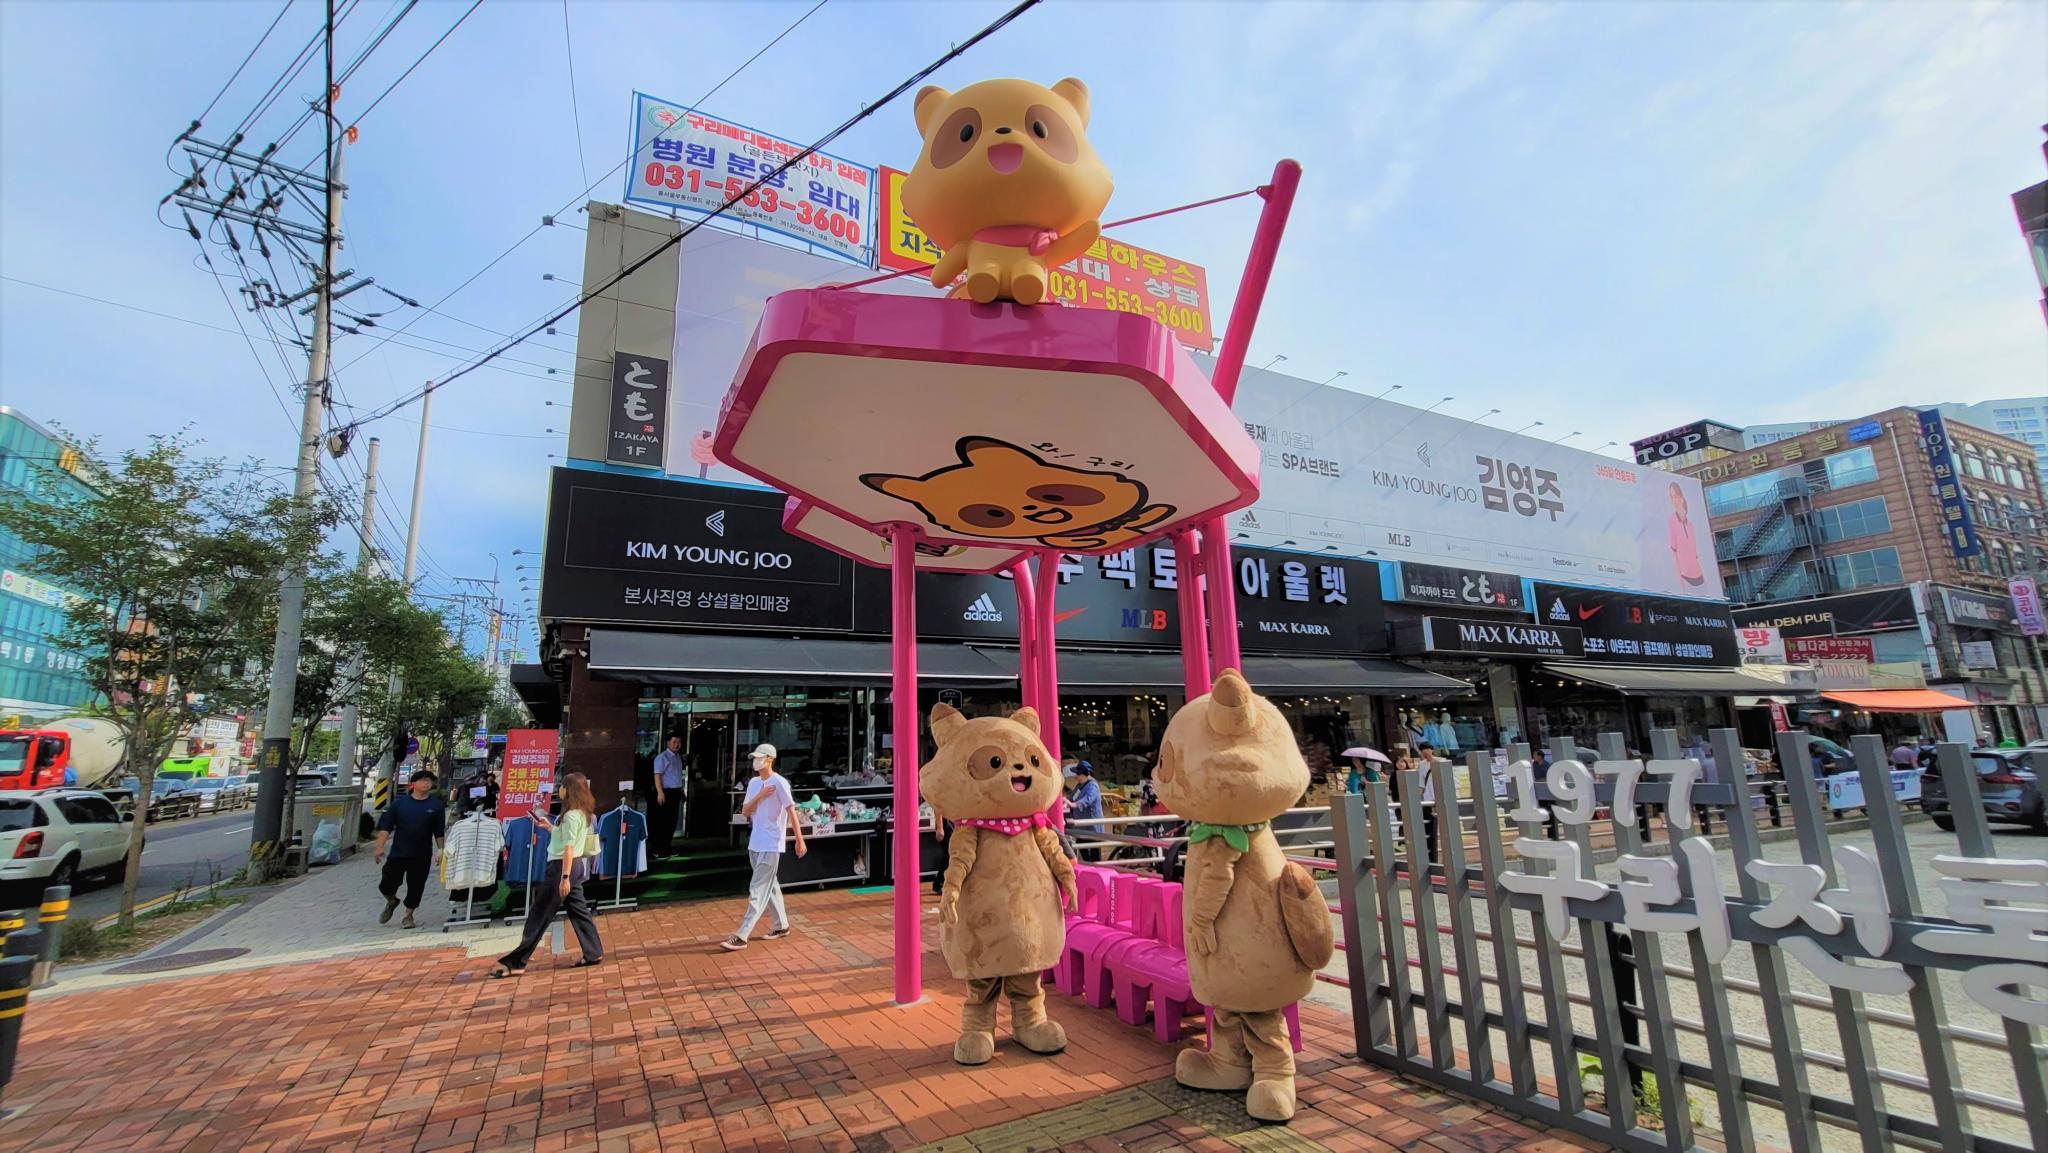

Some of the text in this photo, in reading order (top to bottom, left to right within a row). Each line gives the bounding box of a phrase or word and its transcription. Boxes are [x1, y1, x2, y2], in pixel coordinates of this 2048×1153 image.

[653, 137, 716, 169] 병원
[808, 180, 860, 220] 임대
[645, 162, 860, 245] 031-553-3600
[1050, 271, 1204, 334] 031-553-3600
[1144, 278, 1200, 307] 상담
[624, 361, 658, 421] とも
[614, 430, 659, 443] IZAKAYA
[1642, 426, 1693, 446] MOTEL
[1925, 422, 1943, 457] TOP
[626, 445, 647, 456] 1F
[1636, 433, 1702, 465] TOP
[1282, 453, 1340, 477] SPA브랜드
[1372, 455, 1564, 522] KIM YOUNG JOO 김영주
[1388, 532, 1412, 548] MLB
[626, 541, 792, 570] KIM YOUNG JOO
[624, 586, 790, 613] 본사직영 상설할인매장
[1442, 588, 1457, 599] 도모
[1462, 574, 1496, 604] とも
[1510, 598, 1518, 607] 1F
[963, 609, 1003, 623] adidas
[1121, 607, 1168, 631] MLB
[1550, 612, 1570, 621] adidas
[1655, 614, 1678, 623] SPYDER
[1684, 616, 1728, 628] MAX KARRA
[1804, 612, 1833, 624] PUB
[1259, 621, 1288, 633] MAX
[1290, 622, 1331, 636] KARRA
[1458, 624, 1562, 647] MAX KARRA
[1610, 638, 1640, 655] 아웃도어
[1643, 640, 1672, 657] 골프웨어
[508, 768, 549, 779] 건물 뒤에
[1508, 759, 1701, 830] 1977
